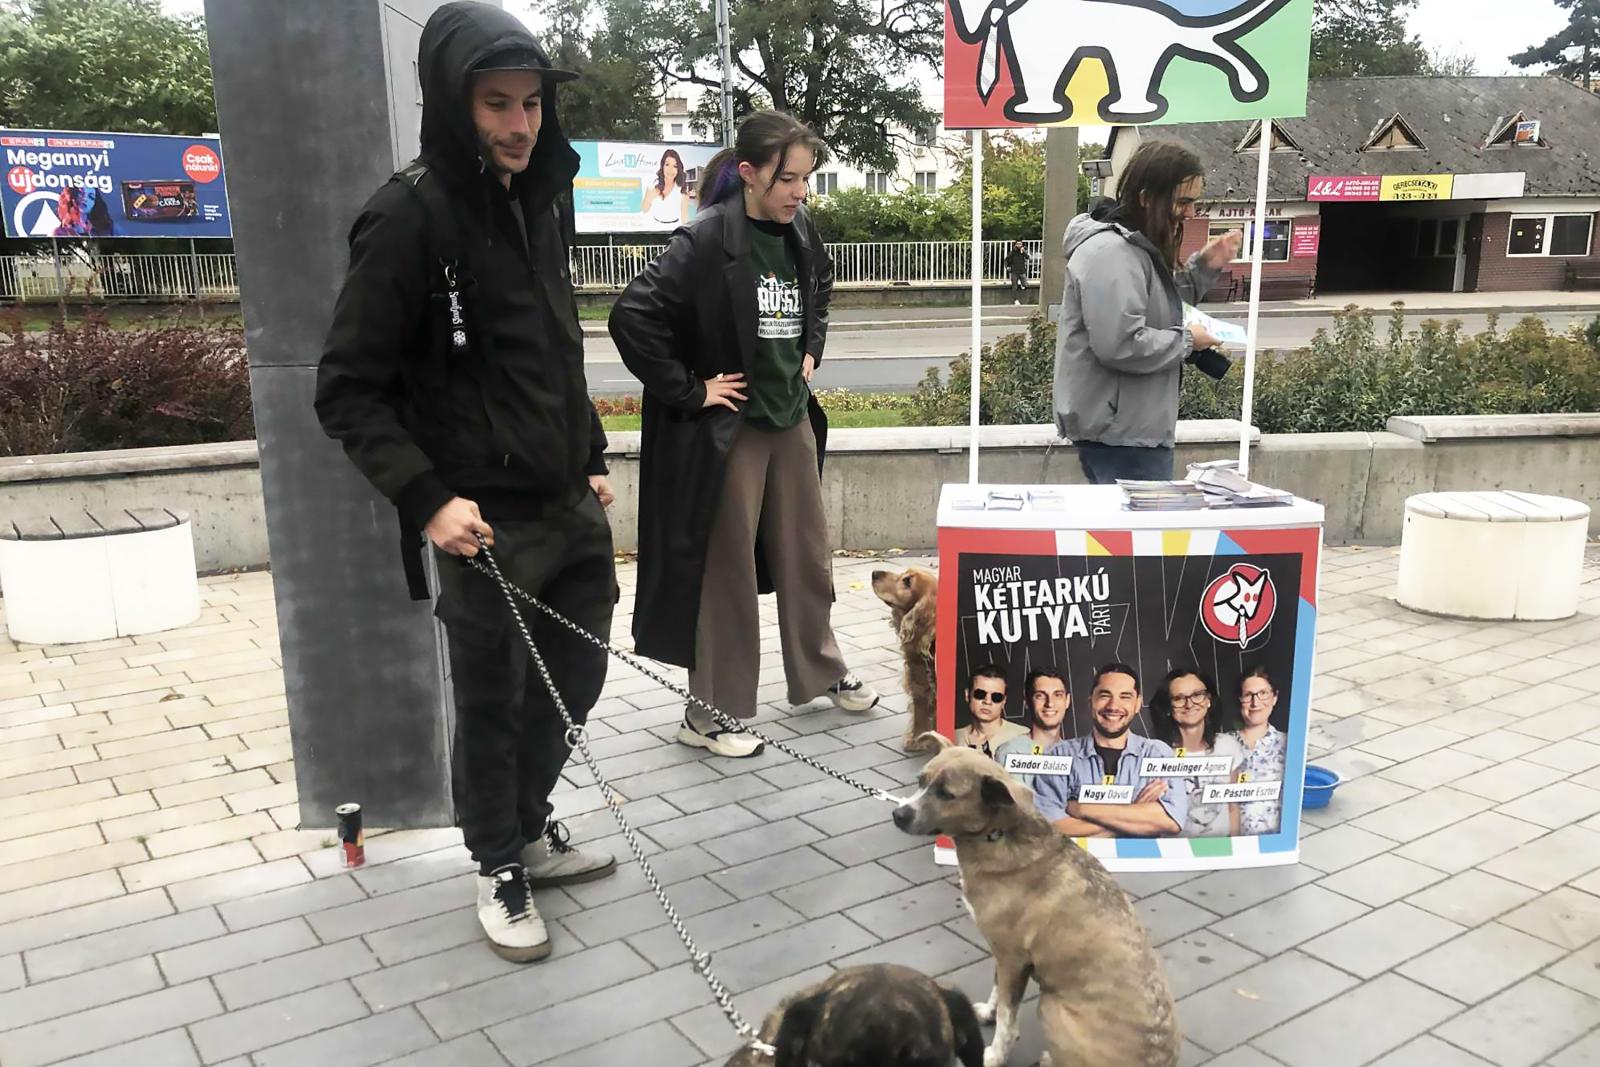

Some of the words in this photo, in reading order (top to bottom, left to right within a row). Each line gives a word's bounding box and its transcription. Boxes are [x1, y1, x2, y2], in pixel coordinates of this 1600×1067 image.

[6, 149, 110, 172] Megannyi
[186, 153, 214, 165] Csak
[185, 162, 219, 172] nálunk!
[10, 168, 114, 194] újdonság
[973, 566, 1021, 584] MAGYAR
[974, 567, 1110, 611] KÉTFARKÚ
[976, 604, 1089, 645] KUTYA
[1089, 603, 1112, 636] PÁRT
[1010, 758, 1041, 769] Sándor
[1042, 760, 1068, 771] Balázs
[1146, 763, 1158, 773] Dr.
[1160, 762, 1203, 774] Neulinger
[1083, 788, 1106, 801] Nagy
[1210, 789, 1222, 799] Dr.
[1223, 787, 1255, 799] Pásztor
[1255, 786, 1279, 797] Eszter
